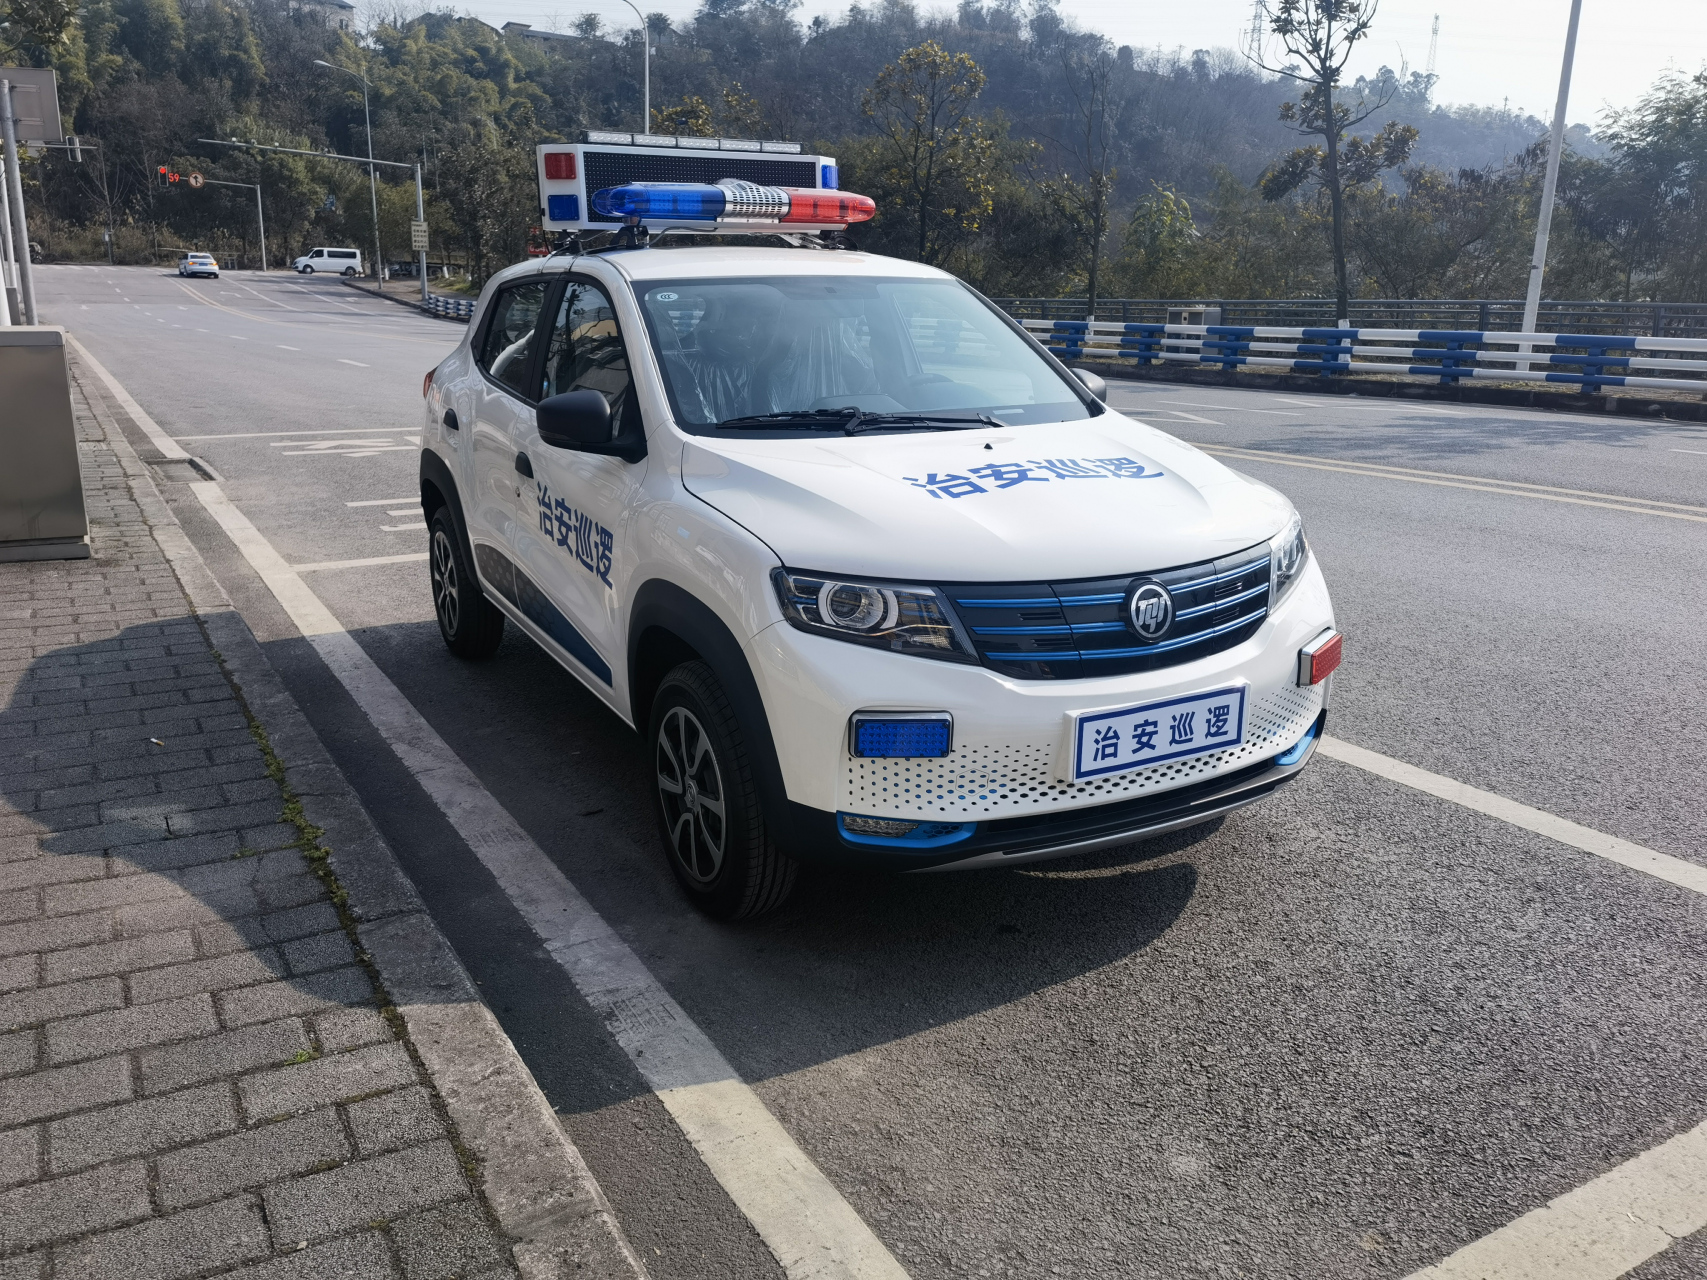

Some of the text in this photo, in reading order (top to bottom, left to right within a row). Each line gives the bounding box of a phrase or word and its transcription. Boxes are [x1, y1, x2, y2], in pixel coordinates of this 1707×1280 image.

[169, 174, 179, 182] 59
[902, 456, 1165, 499] 治安巡逻
[537, 481, 614, 590] 治安巡逻
[1092, 704, 1230, 762] 治安巡逻
